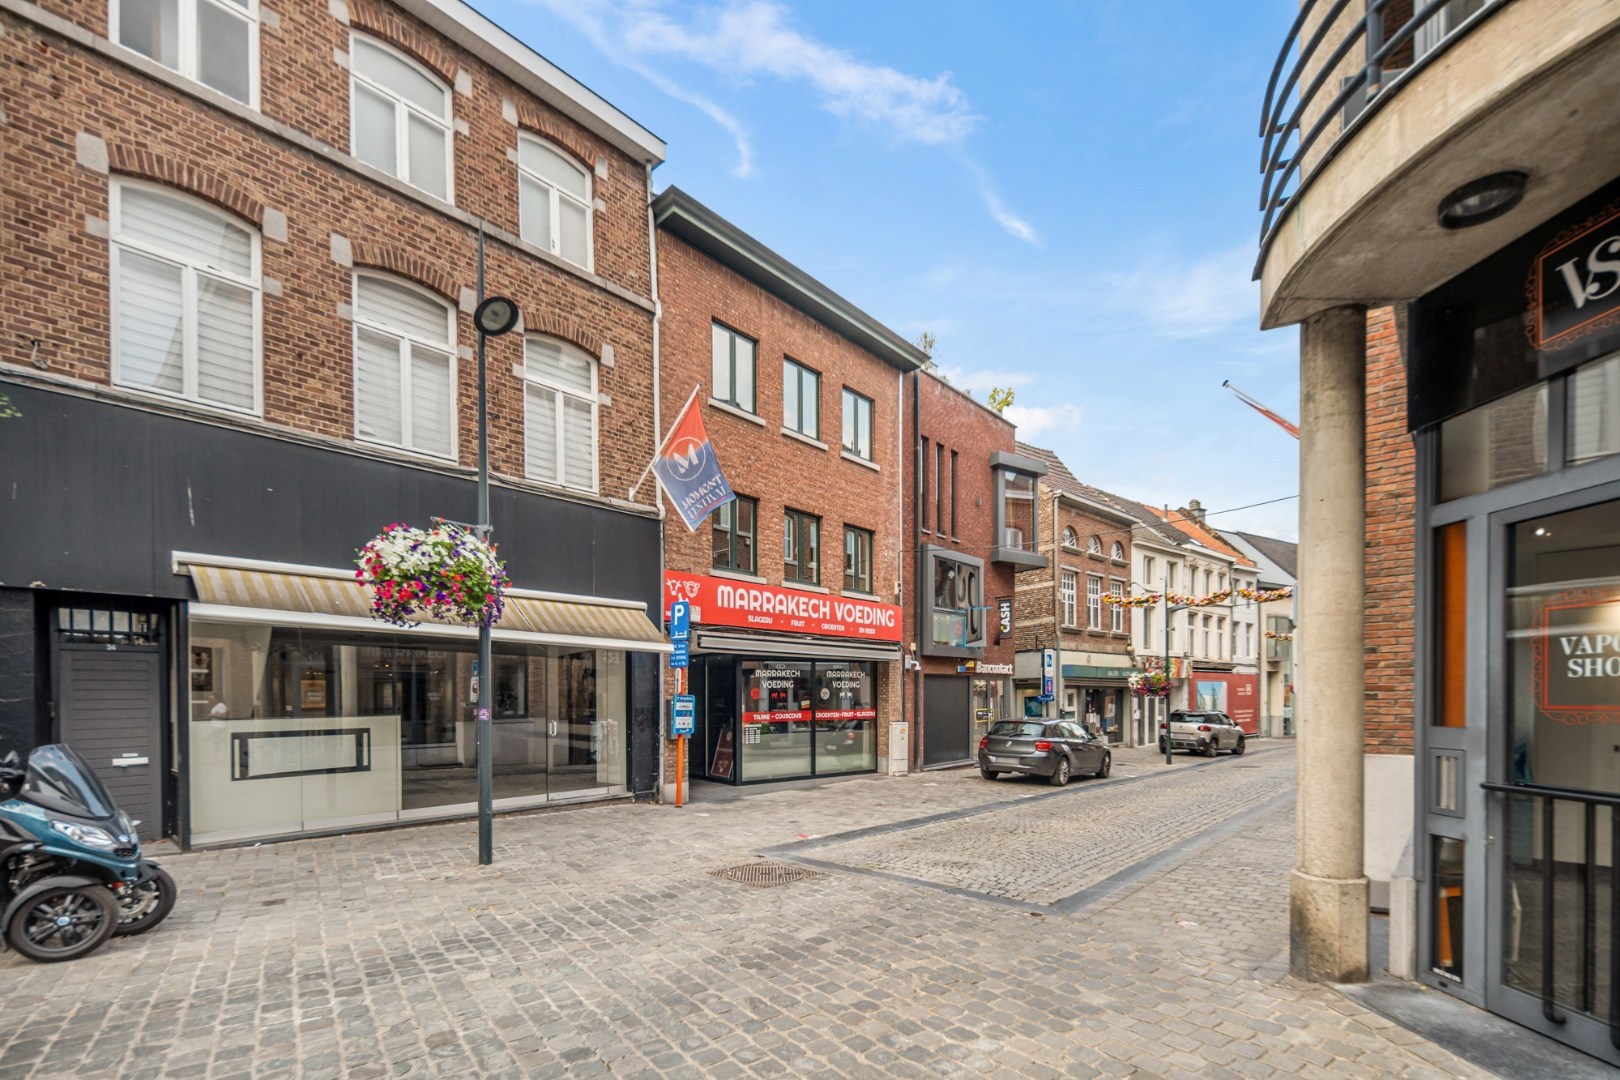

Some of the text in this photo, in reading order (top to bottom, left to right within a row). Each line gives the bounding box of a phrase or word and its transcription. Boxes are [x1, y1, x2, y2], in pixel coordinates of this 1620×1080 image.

[673, 443, 699, 474] M
[688, 485, 730, 519] FESTIVAL
[717, 584, 830, 620] MARRAKECH
[834, 601, 895, 628] VOEDING
[674, 604, 685, 626] P
[1000, 602, 1010, 633] CASH
[790, 619, 805, 628] FRUIT
[821, 623, 845, 632] GROENTEN
[755, 669, 800, 679] MARRAKECH
[826, 670, 866, 679] MARRAKECH
[976, 660, 1013, 675] Bancontact
[761, 680, 794, 689] VOEDING
[832, 680, 860, 689] VOEDING
